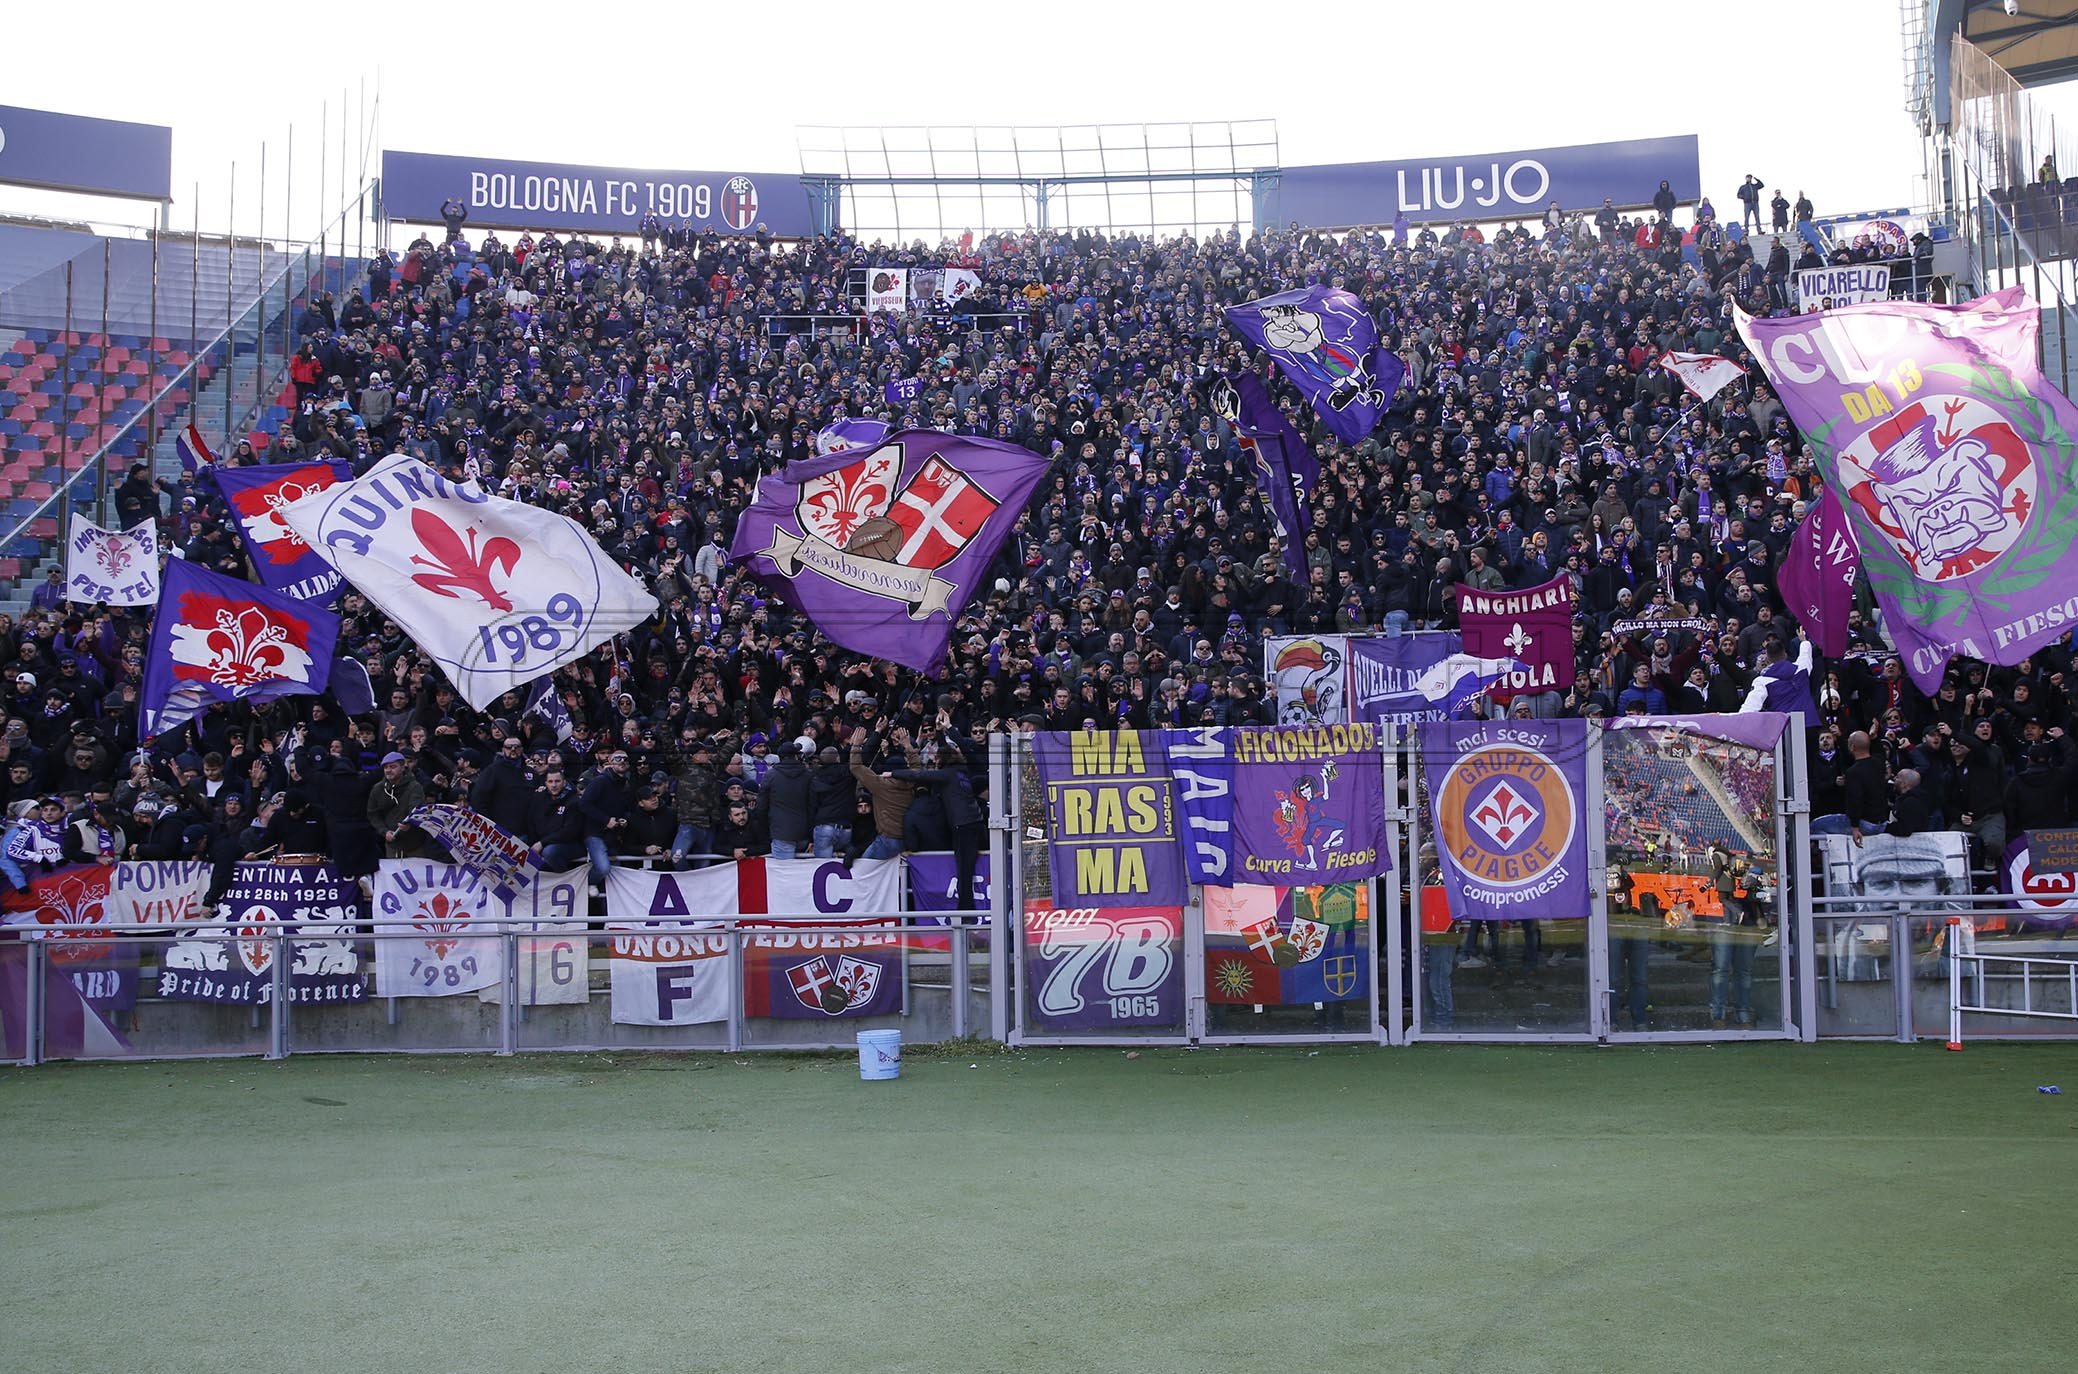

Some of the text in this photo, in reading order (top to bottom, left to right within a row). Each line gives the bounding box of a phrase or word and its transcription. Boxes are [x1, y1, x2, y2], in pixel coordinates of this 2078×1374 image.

[471, 171, 711, 219] BOLOGNA FC 1909
[731, 178, 749, 190] BFC
[1801, 270, 1888, 297] VICARELLO
[898, 386, 916, 398] 13
[1840, 358, 1924, 424] DA 13
[72, 570, 156, 602] PER TE!
[1462, 584, 1568, 616] ANGHIARI
[479, 593, 583, 663] 1989
[1612, 620, 1644, 634] VACILLO
[1646, 620, 1660, 628] MA
[1661, 620, 1679, 628] NON
[1353, 650, 1403, 699] QUELLI
[1071, 730, 1146, 776] MA
[1234, 722, 1375, 763] AFICIONADOS
[1455, 727, 1548, 753] mai scesi
[1459, 752, 1547, 785] GRUPPO
[1063, 785, 1158, 835] RAS
[1163, 783, 1173, 836] 1993
[118, 860, 212, 893] POMPA
[1076, 847, 1149, 895] MA
[1245, 846, 1377, 873] Curva Fiesole
[1459, 841, 1555, 880] PIAGGE
[222, 889, 339, 901] ust 26th 1926
[645, 860, 854, 927] A C
[1462, 863, 1570, 909] compromessi
[409, 956, 478, 987] 1989
[1038, 916, 1174, 1016] 7B
[158, 971, 362, 1005] Pride of Forence
[656, 965, 694, 1021] F
[1108, 996, 1160, 1019] 1965
